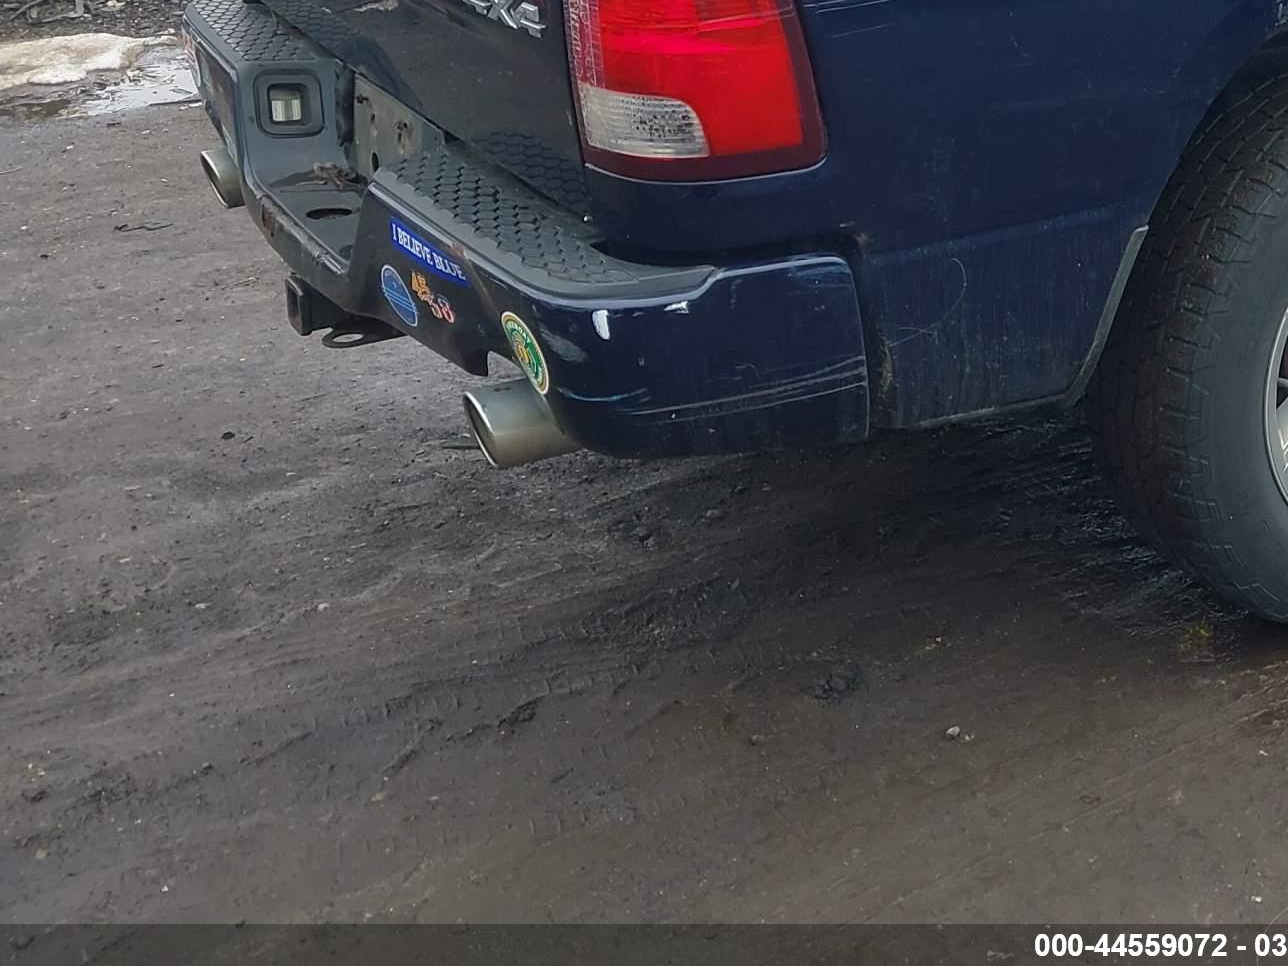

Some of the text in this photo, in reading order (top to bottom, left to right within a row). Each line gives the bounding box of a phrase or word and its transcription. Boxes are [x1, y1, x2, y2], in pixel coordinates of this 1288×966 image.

[391, 222, 398, 241] I
[396, 226, 434, 266] BELIEVE
[432, 252, 467, 281] BLUE
